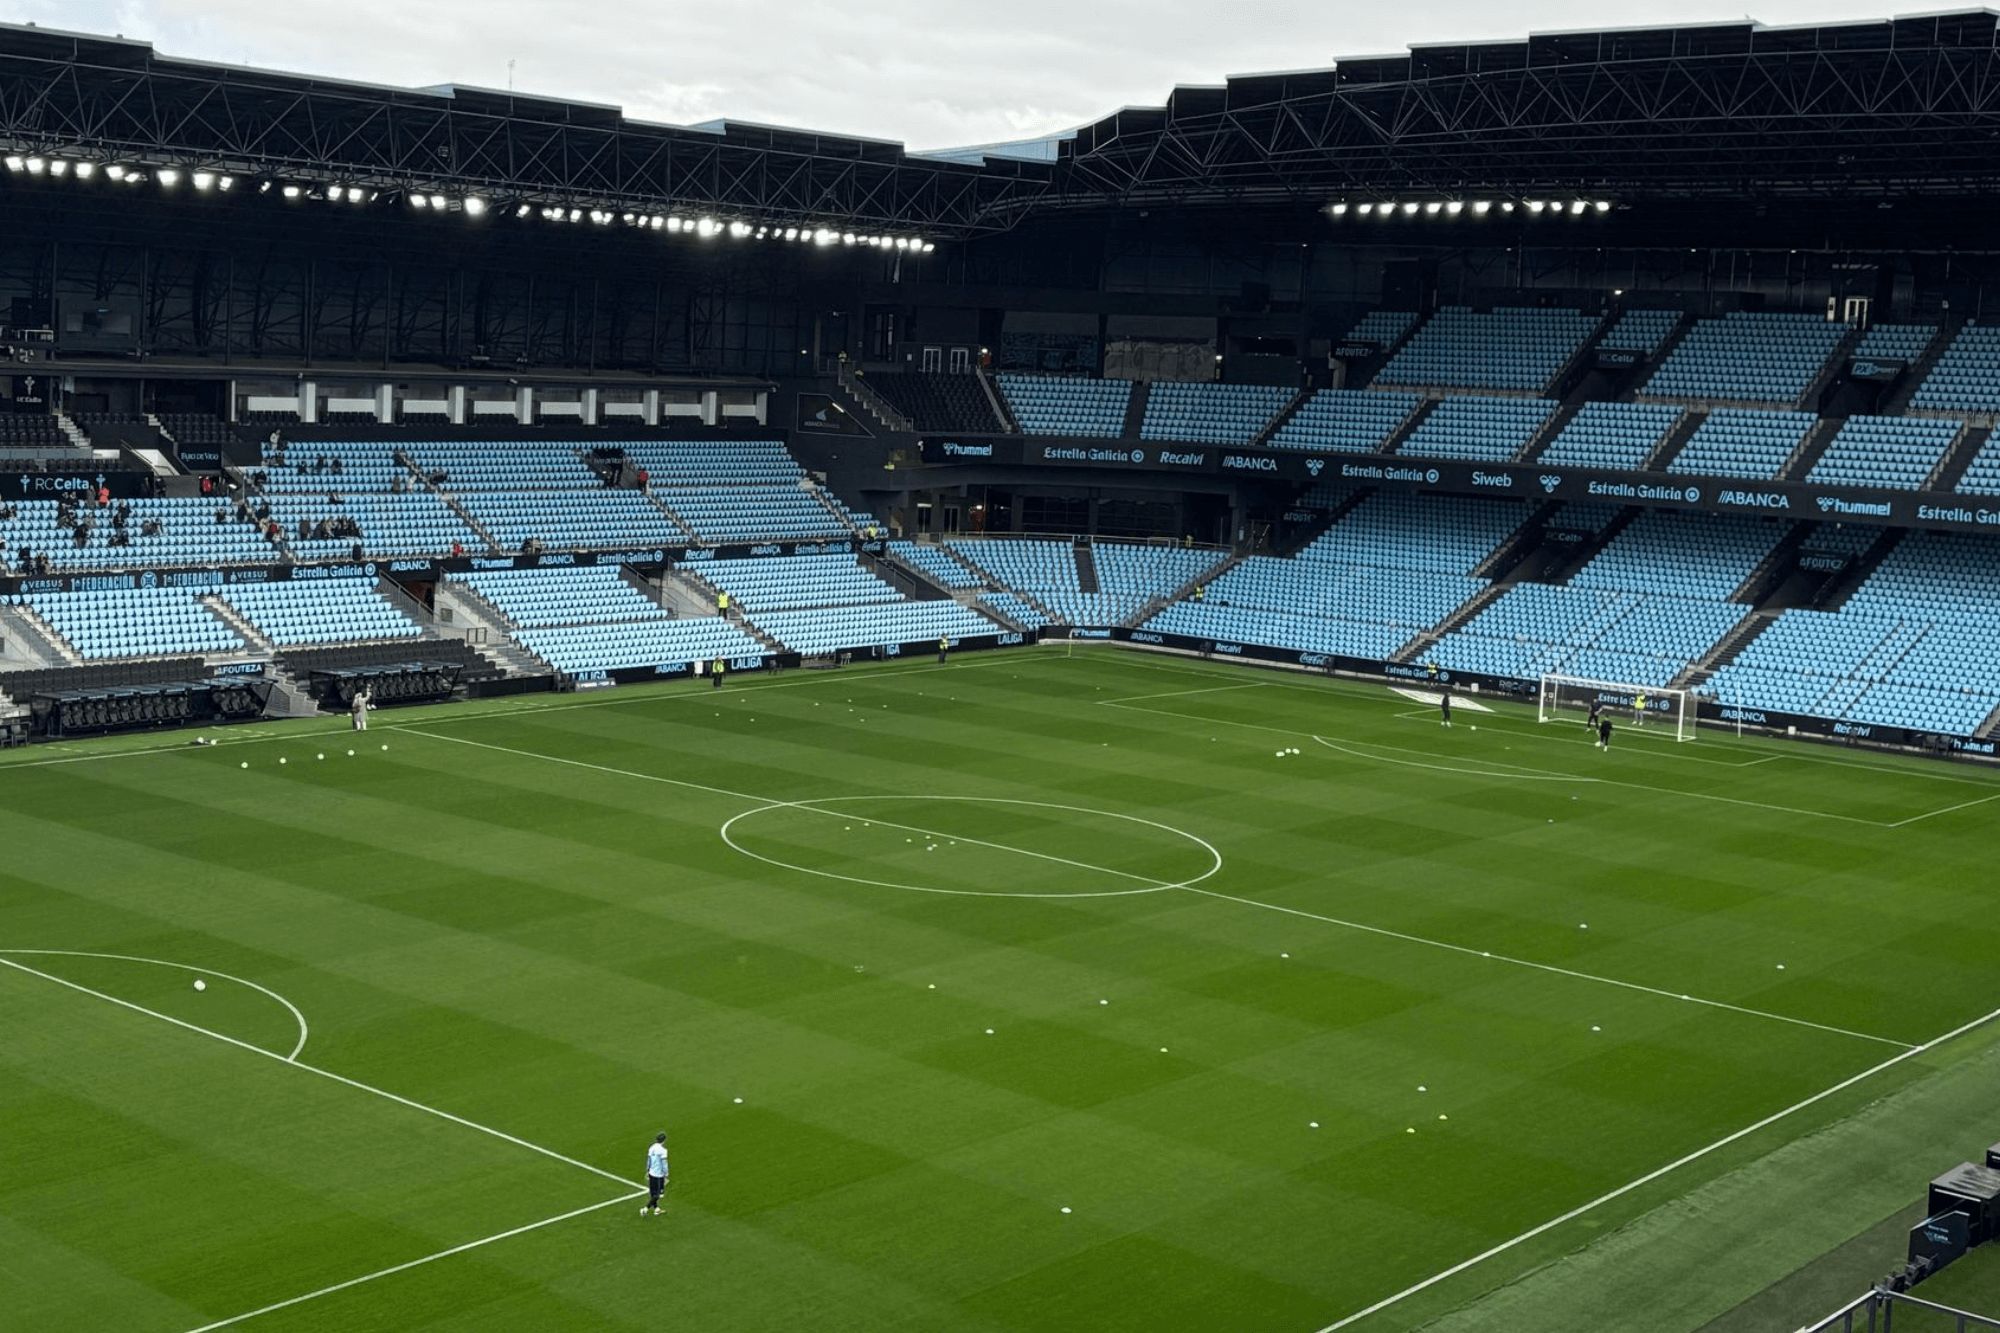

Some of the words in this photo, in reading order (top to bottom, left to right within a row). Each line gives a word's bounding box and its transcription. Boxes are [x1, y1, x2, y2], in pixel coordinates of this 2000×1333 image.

[953, 443, 993, 456] hummel
[1043, 447, 1086, 459] Estrella
[1088, 448, 1128, 461] Galicia
[1160, 451, 1204, 465] Recalvi
[1341, 464, 1382, 478] Estrella
[1384, 467, 1423, 482] Galicia
[1472, 471, 1512, 487] Siweb
[1588, 480, 1635, 496] Estrella
[1637, 484, 1682, 500] Galicia
[1834, 498, 1891, 516] hummel
[1917, 505, 1972, 523] Estrella
[291, 567, 328, 578] Estrella
[330, 565, 363, 577] Galicia
[731, 657, 763, 670] LALIGA
